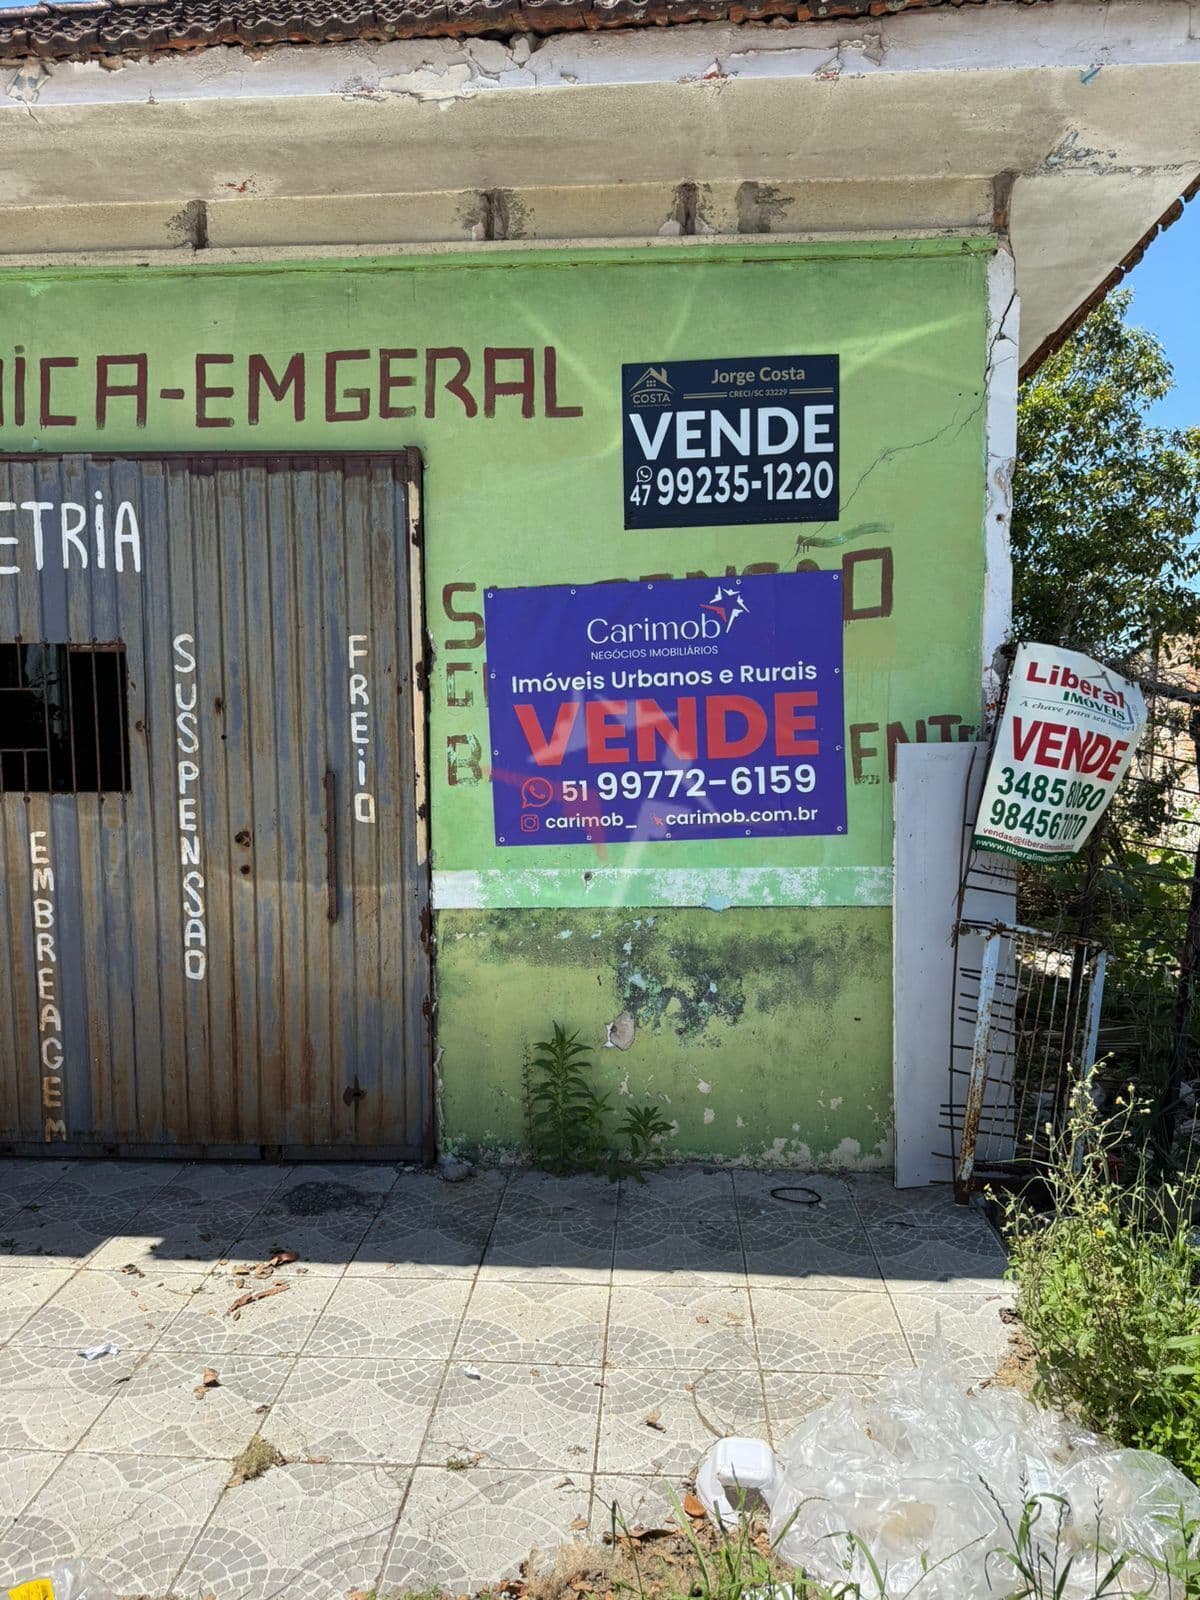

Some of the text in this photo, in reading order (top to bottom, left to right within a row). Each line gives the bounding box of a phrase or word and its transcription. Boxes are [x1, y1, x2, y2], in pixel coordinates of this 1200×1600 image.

[712, 366, 806, 386] Jorge Costa
[728, 388, 788, 398] CRECI/SC 33229
[632, 392, 672, 404] COSTA
[628, 404, 835, 461] VENDE
[630, 460, 834, 507] 47 99235-1220
[586, 612, 721, 645] Carimob
[590, 644, 719, 661] NEGÓCIOS IMOBILIÁRIOS
[512, 671, 605, 695] Imóveis
[611, 668, 713, 690] Urbanos
[719, 672, 734, 684] e
[740, 660, 818, 684] Rurais
[1026, 661, 1125, 709] Liberal
[1019, 700, 1029, 708] A
[1031, 701, 1065, 713] chave
[1065, 707, 1091, 719] para
[512, 690, 820, 767] VENDE
[1012, 716, 1130, 782] VENDE
[562, 764, 817, 802] 51 99772-6159
[666, 806, 819, 827] carimob.com.br
